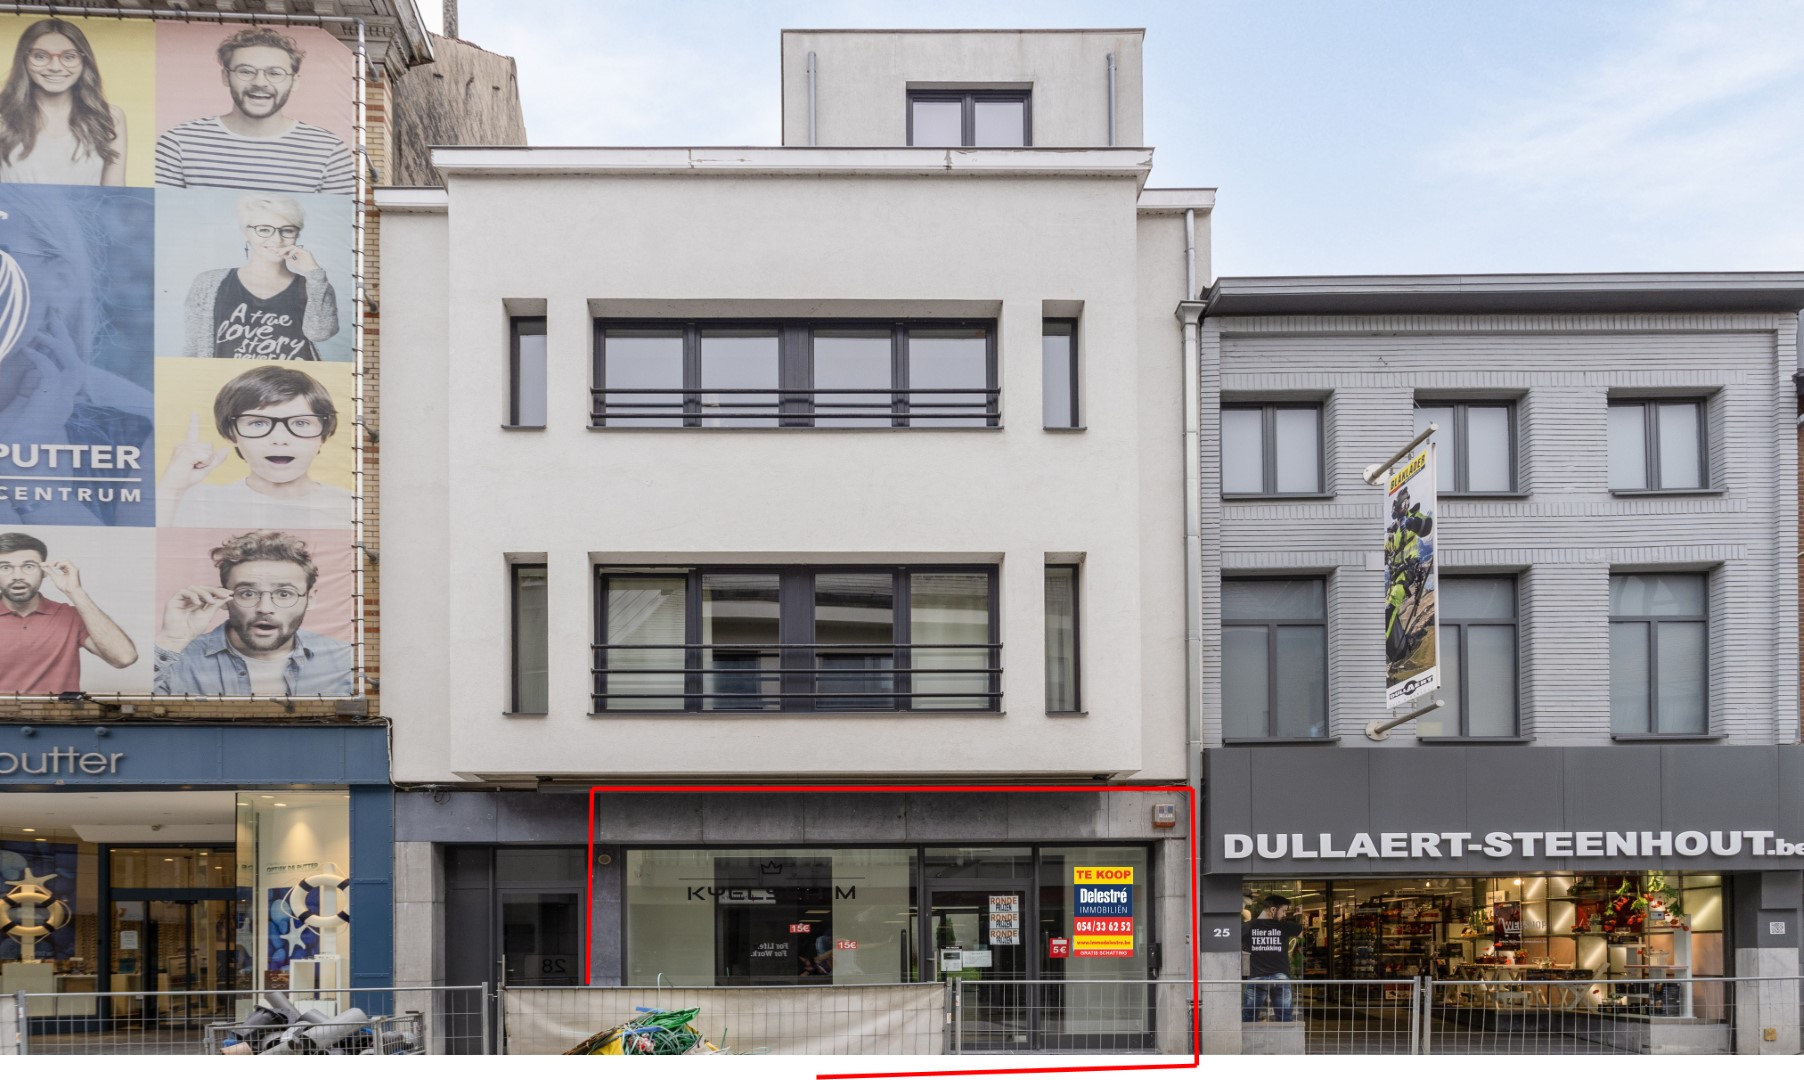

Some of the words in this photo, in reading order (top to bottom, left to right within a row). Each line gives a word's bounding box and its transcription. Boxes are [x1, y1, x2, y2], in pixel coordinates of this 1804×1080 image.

[230, 303, 247, 323] A
[250, 310, 293, 326] true
[216, 320, 274, 343] love
[234, 335, 305, 360] story
[1076, 870, 1092, 879] TE
[1096, 870, 1131, 879] KOOP
[1080, 887, 1127, 903] Delestré
[1080, 905, 1128, 913] IMMOBILIËN
[791, 924, 810, 932] 15€
[1076, 920, 1106, 932] 054/33
[1108, 921, 1119, 931] 62
[1120, 921, 1131, 931] 52
[1213, 928, 1231, 937] 25
[839, 941, 857, 949] 15€
[1252, 937, 1282, 945] TEXTIEL
